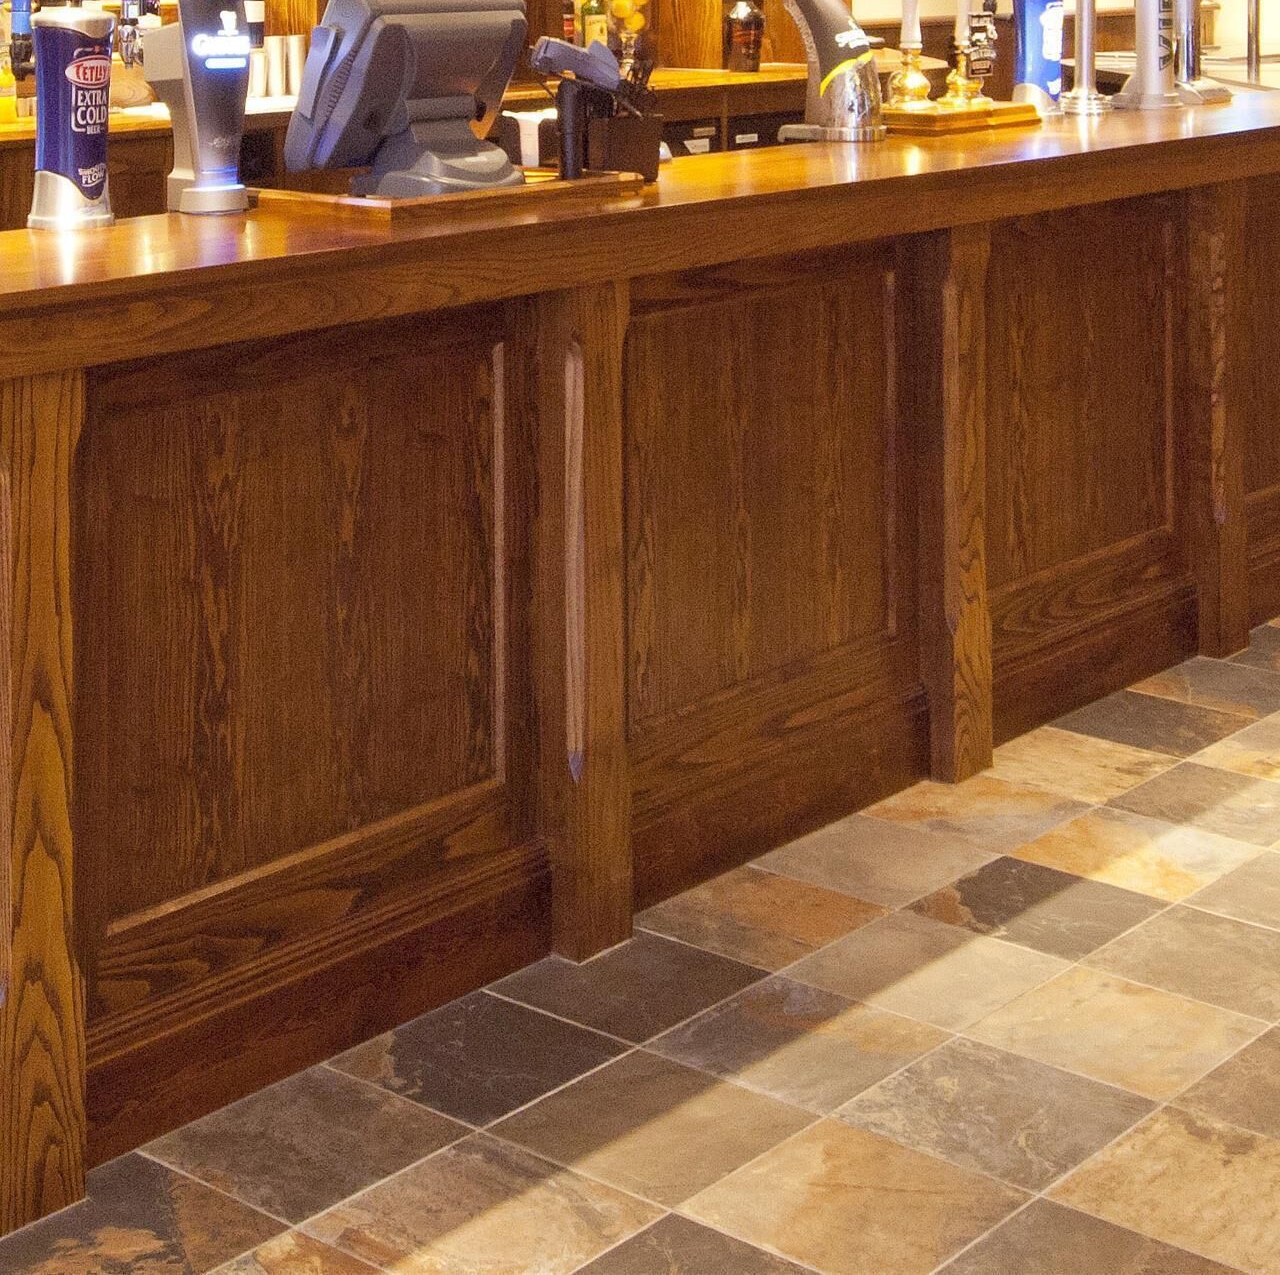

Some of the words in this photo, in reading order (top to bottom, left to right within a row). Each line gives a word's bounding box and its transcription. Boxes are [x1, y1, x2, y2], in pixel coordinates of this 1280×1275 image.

[77, 90, 108, 107] EXTRA
[76, 107, 107, 125] COLD
[86, 124, 101, 135] BEER
[81, 170, 106, 187] FLOW
